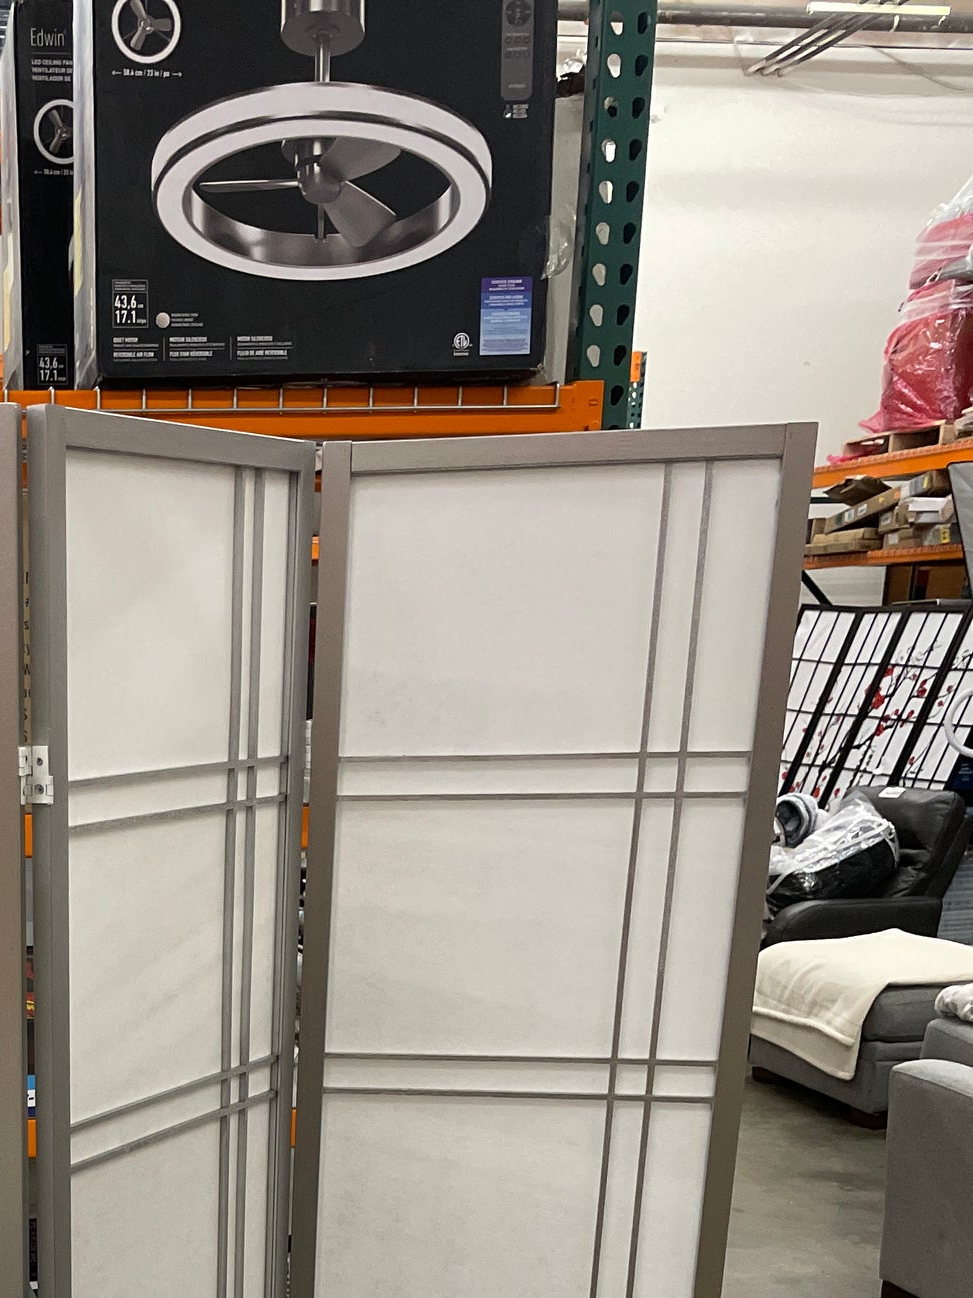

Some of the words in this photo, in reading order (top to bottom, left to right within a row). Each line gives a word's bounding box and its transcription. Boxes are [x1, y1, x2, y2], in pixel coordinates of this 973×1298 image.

[30, 28, 65, 47] Edwin
[114, 294, 137, 310] 43,6
[115, 310, 136, 324] 17.1
